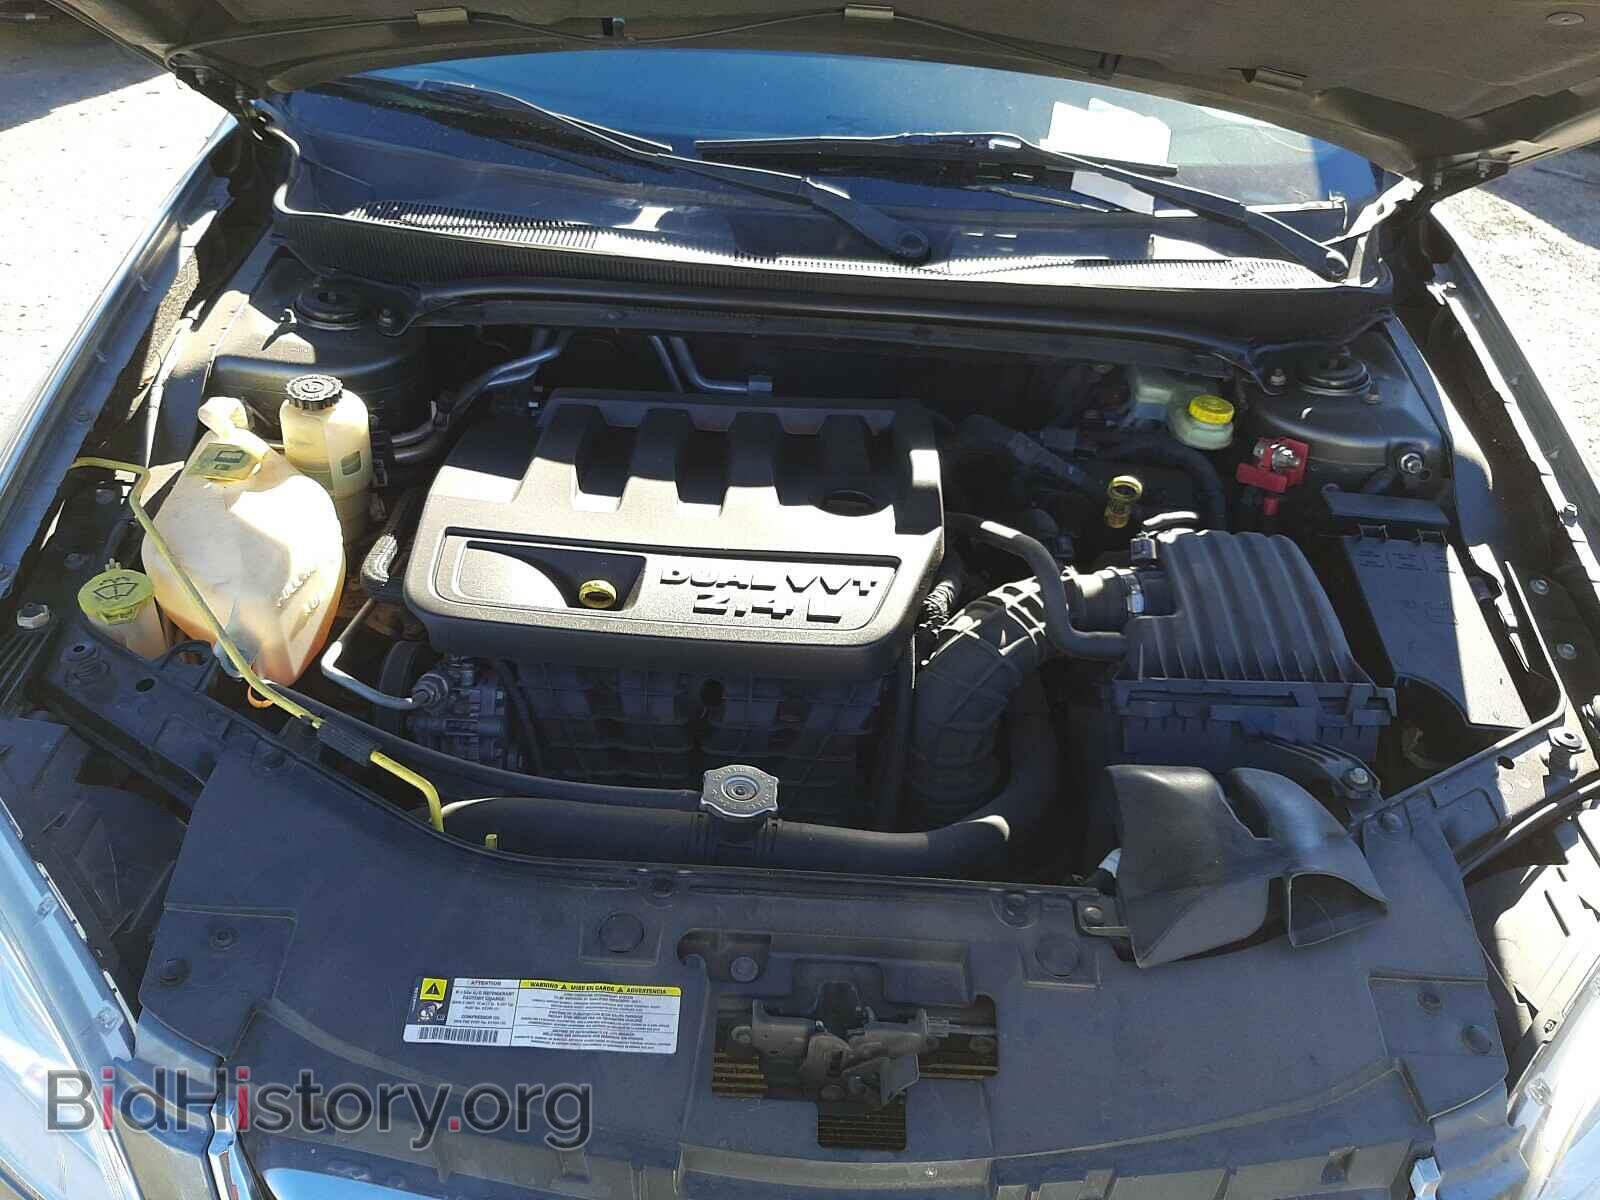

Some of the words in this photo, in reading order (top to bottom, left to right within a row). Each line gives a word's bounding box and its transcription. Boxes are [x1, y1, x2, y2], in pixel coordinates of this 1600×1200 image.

[660, 568, 776, 591] DUAL
[785, 572, 877, 597] VVT
[530, 981, 558, 989] WARNING
[595, 984, 615, 992] GARDE
[626, 987, 667, 995] ADVERTENCIA
